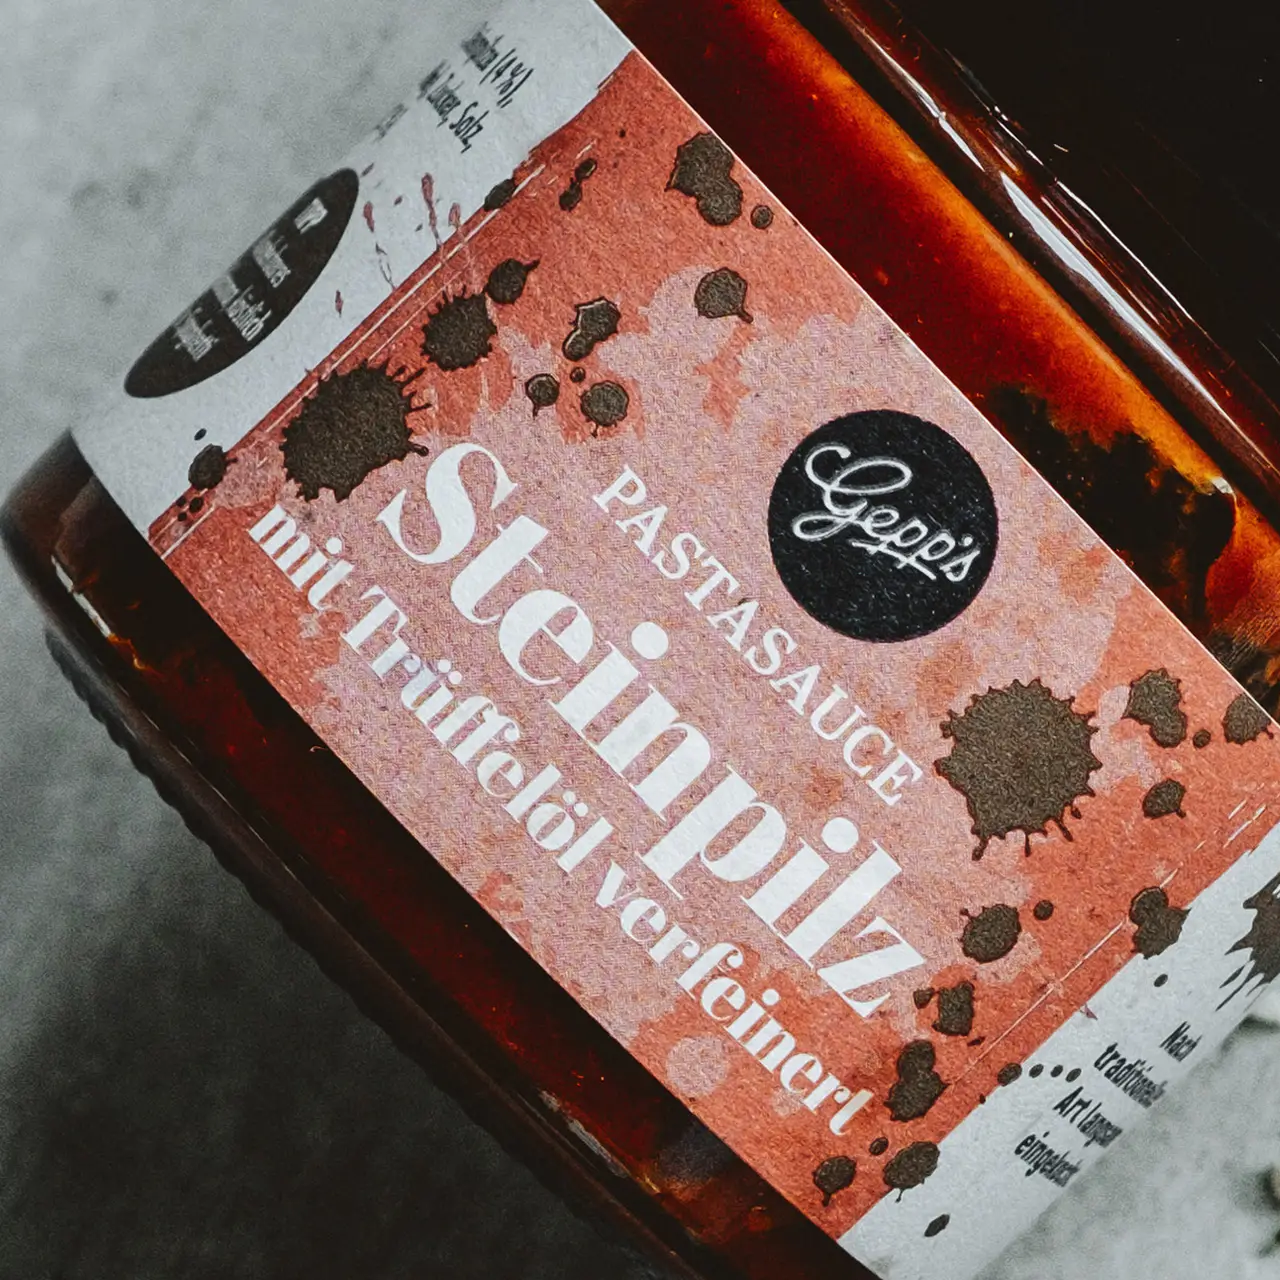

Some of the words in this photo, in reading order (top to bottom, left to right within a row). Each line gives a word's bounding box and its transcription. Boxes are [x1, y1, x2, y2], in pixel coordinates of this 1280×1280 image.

[376, 442, 926, 1019] Steinpilz
[593, 465, 924, 806] PASTASAUCE
[249, 505, 352, 612] mit
[342, 585, 613, 874] Trüffelöl
[594, 860, 874, 1135] verfeinert
[1054, 1086, 1093, 1127] Art
[1160, 1021, 1202, 1062] Nach
